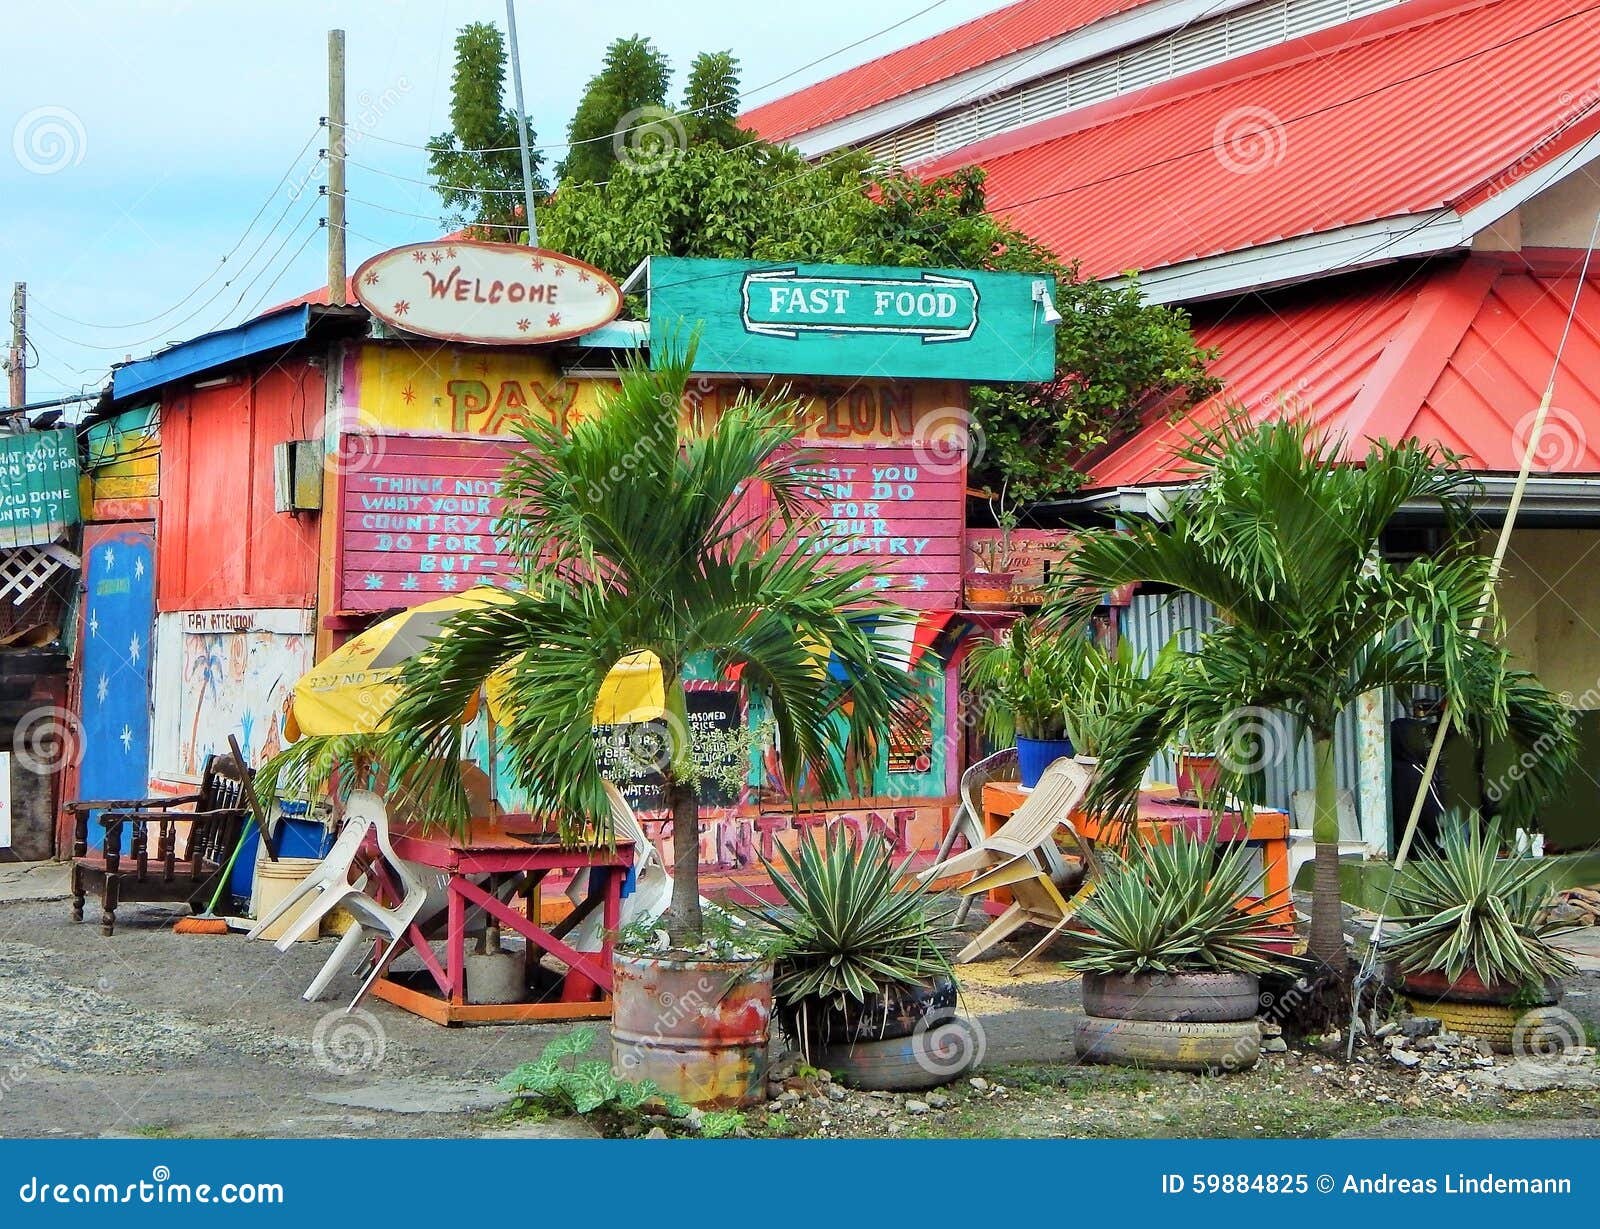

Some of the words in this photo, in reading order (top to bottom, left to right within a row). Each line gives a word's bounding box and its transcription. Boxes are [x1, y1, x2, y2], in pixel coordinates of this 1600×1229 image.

[423, 266, 558, 304] WELCOME
[768, 286, 849, 314] FAST
[874, 291, 957, 318] FOOD
[446, 380, 580, 436] PAY
[26, 447, 68, 463] YOUR
[26, 462, 47, 473] DO
[53, 458, 77, 471] FOR
[789, 467, 856, 482] WHAT
[872, 467, 918, 482] YOU
[29, 489, 72, 503] DONE
[455, 481, 505, 495] NOT
[871, 483, 915, 500] DO
[361, 495, 422, 511] WHAT
[429, 497, 490, 513] YOUR
[832, 503, 879, 518] FOR
[362, 514, 480, 533] COUNTRY
[820, 519, 890, 536] YOUR
[376, 534, 413, 551] DO
[428, 535, 483, 554] FOR
[188, 613, 206, 629] PAY
[211, 613, 255, 630] ATTENTION
